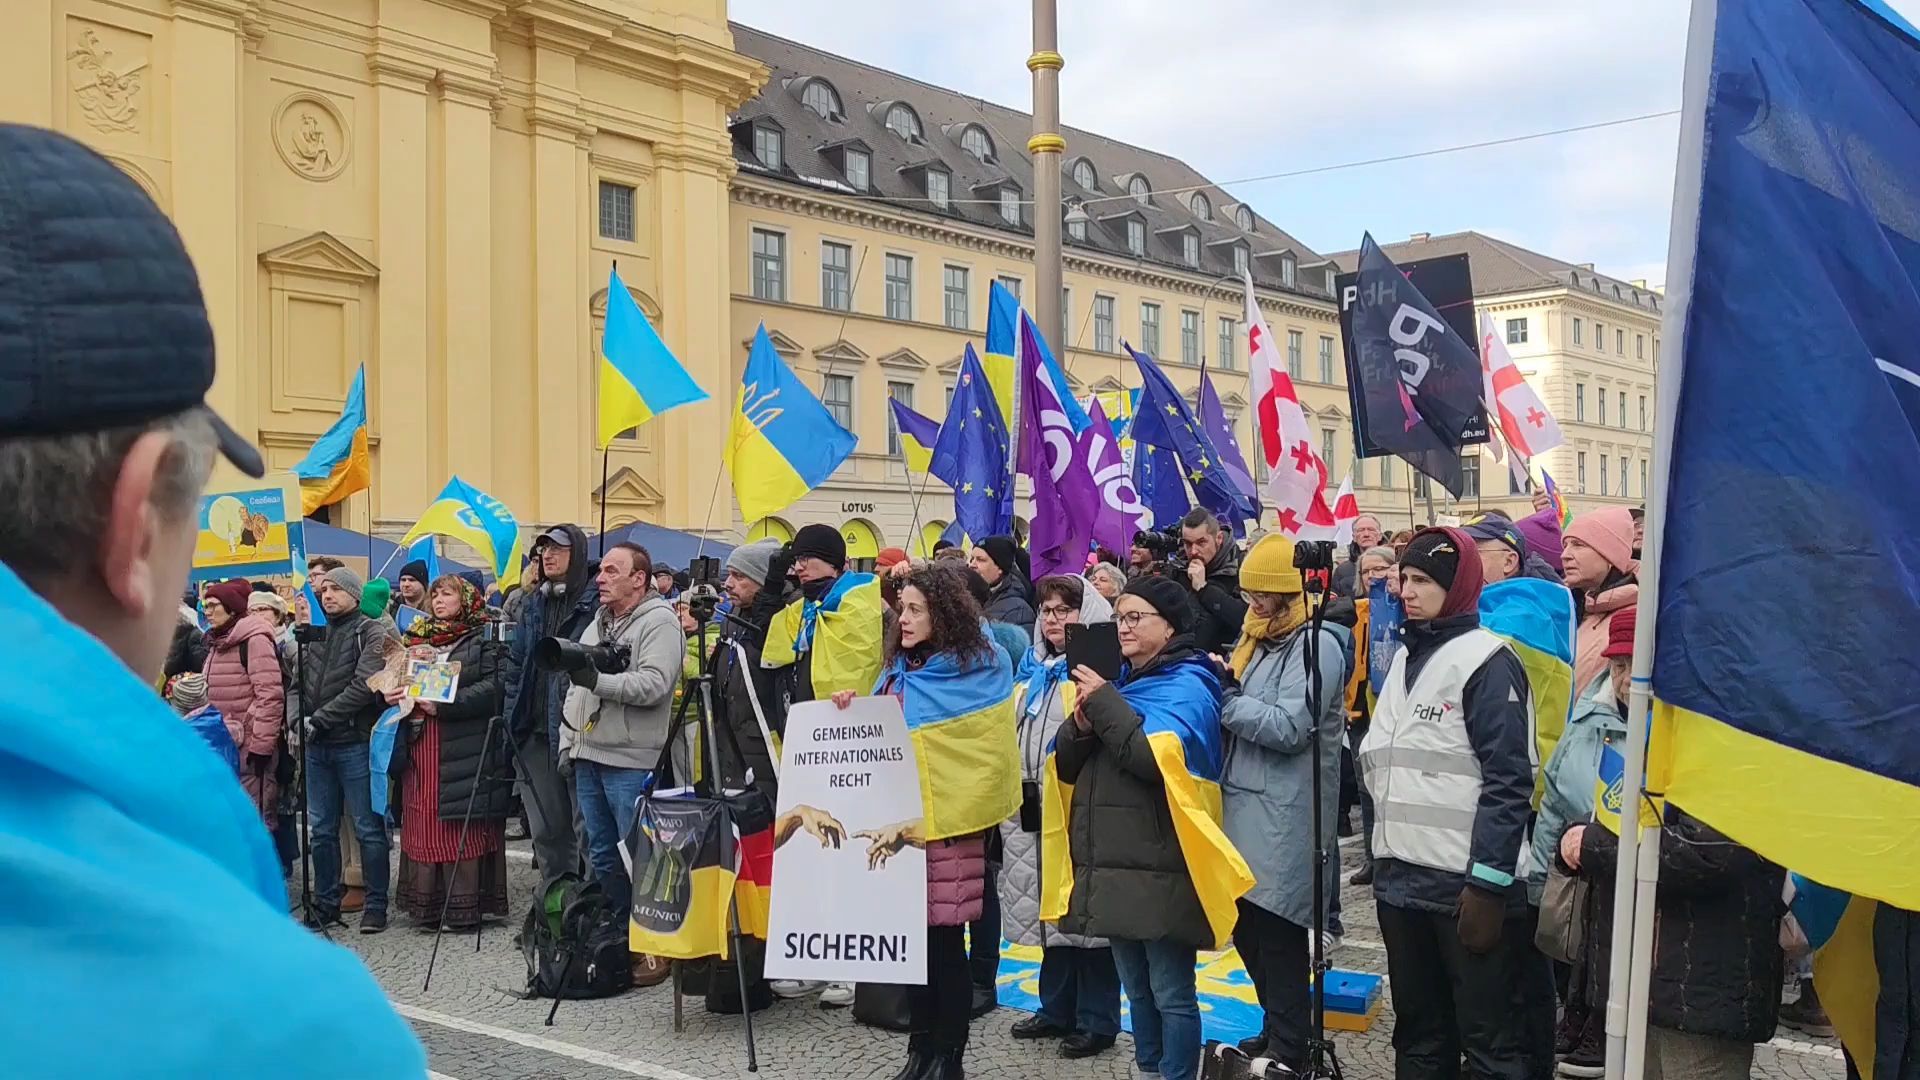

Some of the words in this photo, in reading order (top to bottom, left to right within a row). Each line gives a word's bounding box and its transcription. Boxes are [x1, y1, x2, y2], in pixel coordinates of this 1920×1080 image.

[842, 502, 874, 513] LOTUS
[812, 724, 884, 741] GEMEINSAM
[794, 747, 903, 766] INTERNATIONALES
[830, 773, 872, 787] RECHT
[784, 932, 907, 962] SICHERN!
